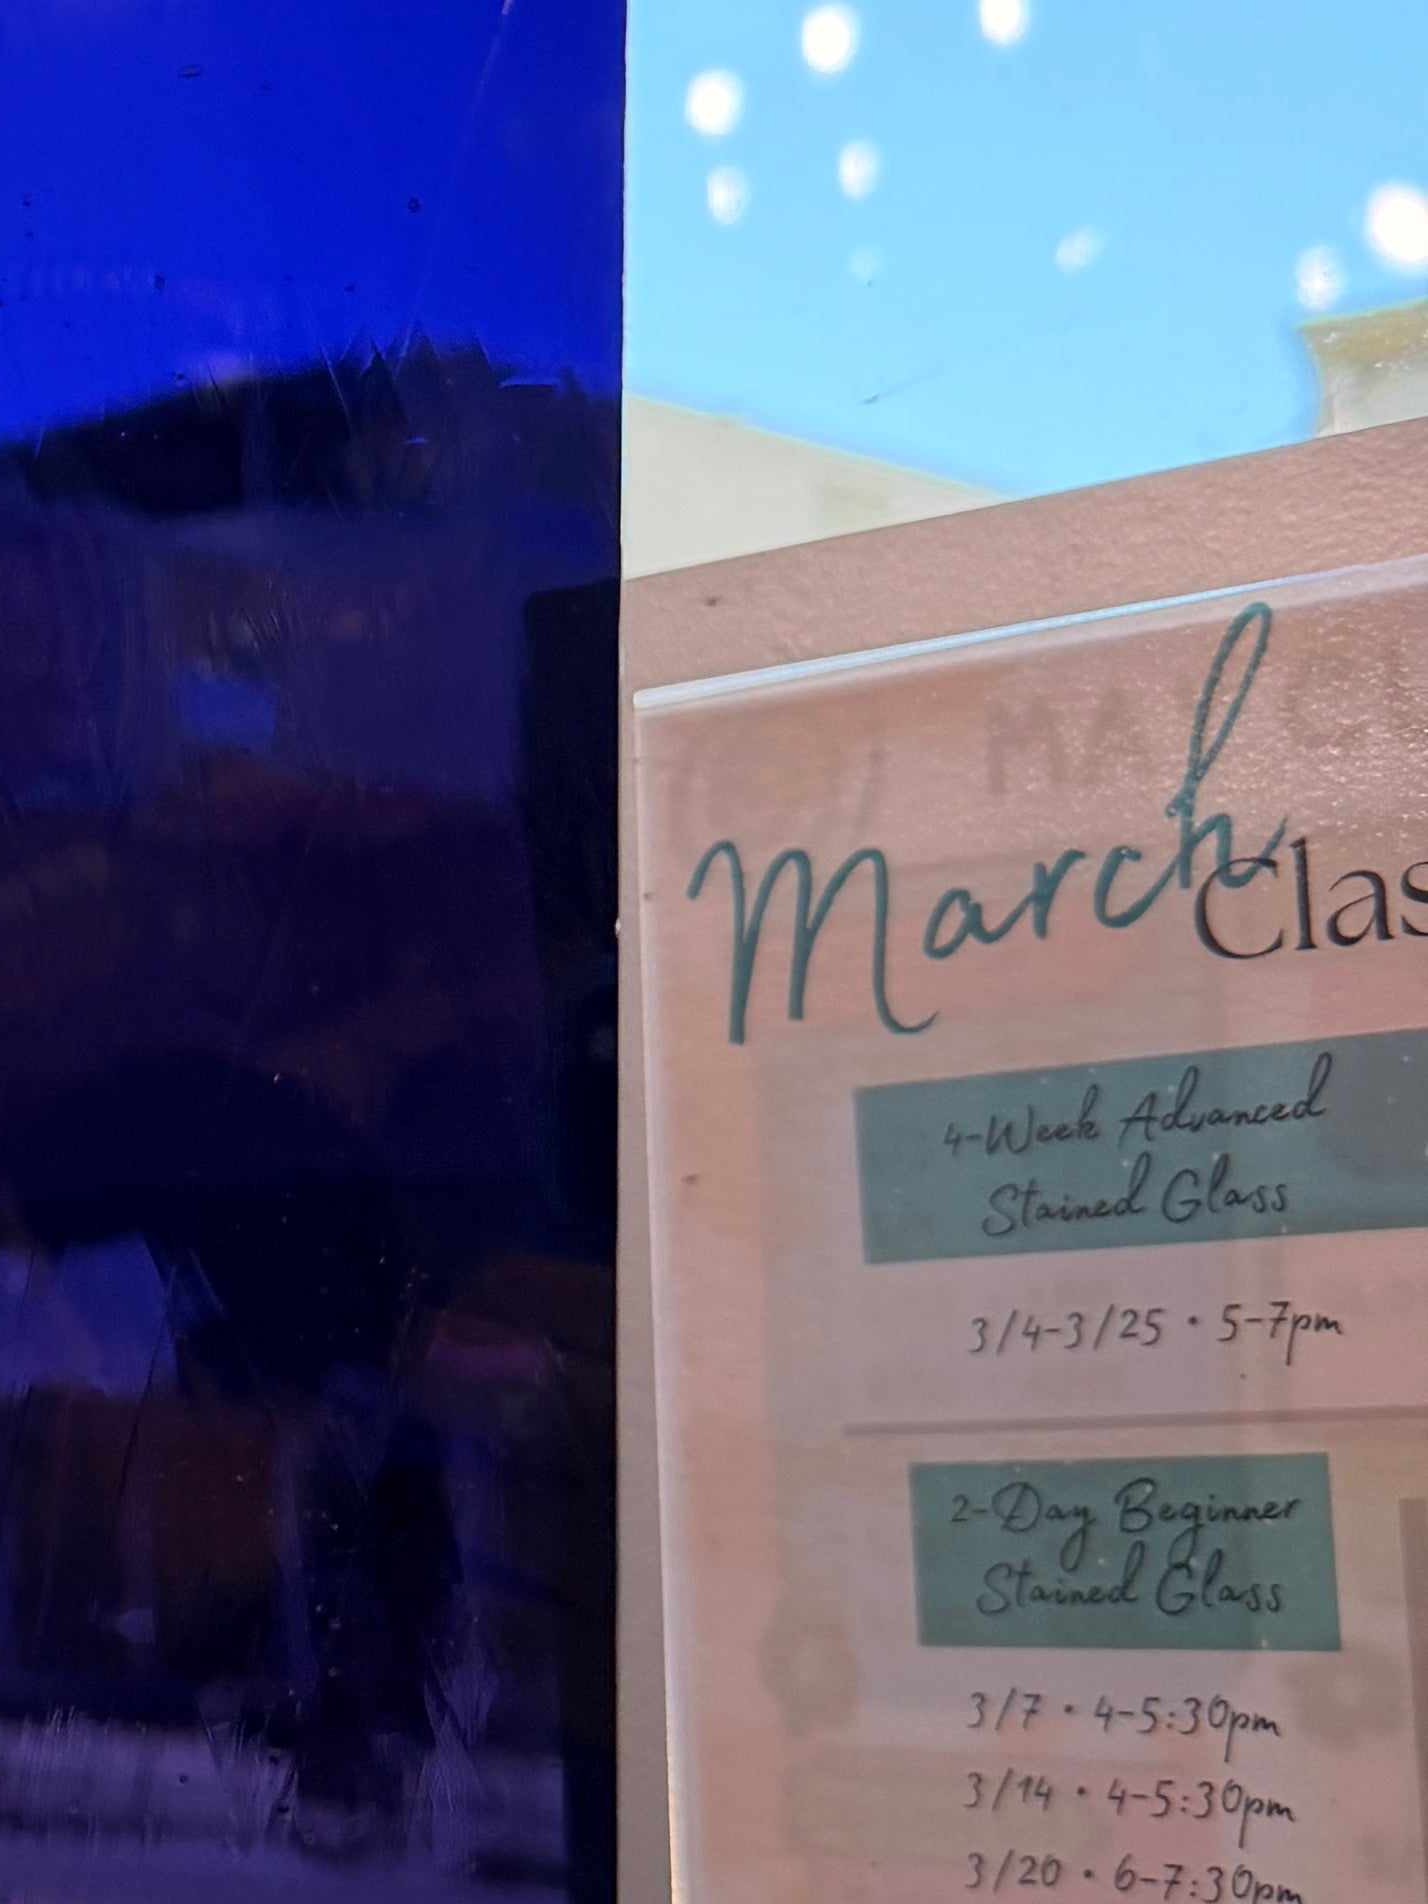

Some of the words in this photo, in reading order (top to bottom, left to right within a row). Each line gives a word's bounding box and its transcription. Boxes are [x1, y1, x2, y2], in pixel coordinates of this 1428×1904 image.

[686, 601, 1287, 1045] March
[943, 1083, 1100, 1156] 4-Week
[1118, 1052, 1333, 1152] Advanced
[982, 1151, 1151, 1236] Stained
[1161, 1153, 1290, 1224] Glass
[969, 1301, 1163, 1355] 3/4-3/25
[1217, 1299, 1344, 1366] 5-7pm
[950, 1481, 1097, 1572] 2-Day
[1114, 1477, 1301, 1564] Beginner
[977, 1540, 1143, 1616] Stained
[1155, 1548, 1283, 1617] Glass
[965, 1687, 1043, 1732] 3/7
[1094, 1695, 1282, 1764] 4-5:30pm
[961, 1768, 1052, 1812] 3/14
[1106, 1778, 1296, 1849] 4-5:30pm
[963, 1850, 1062, 1892] 3/20
